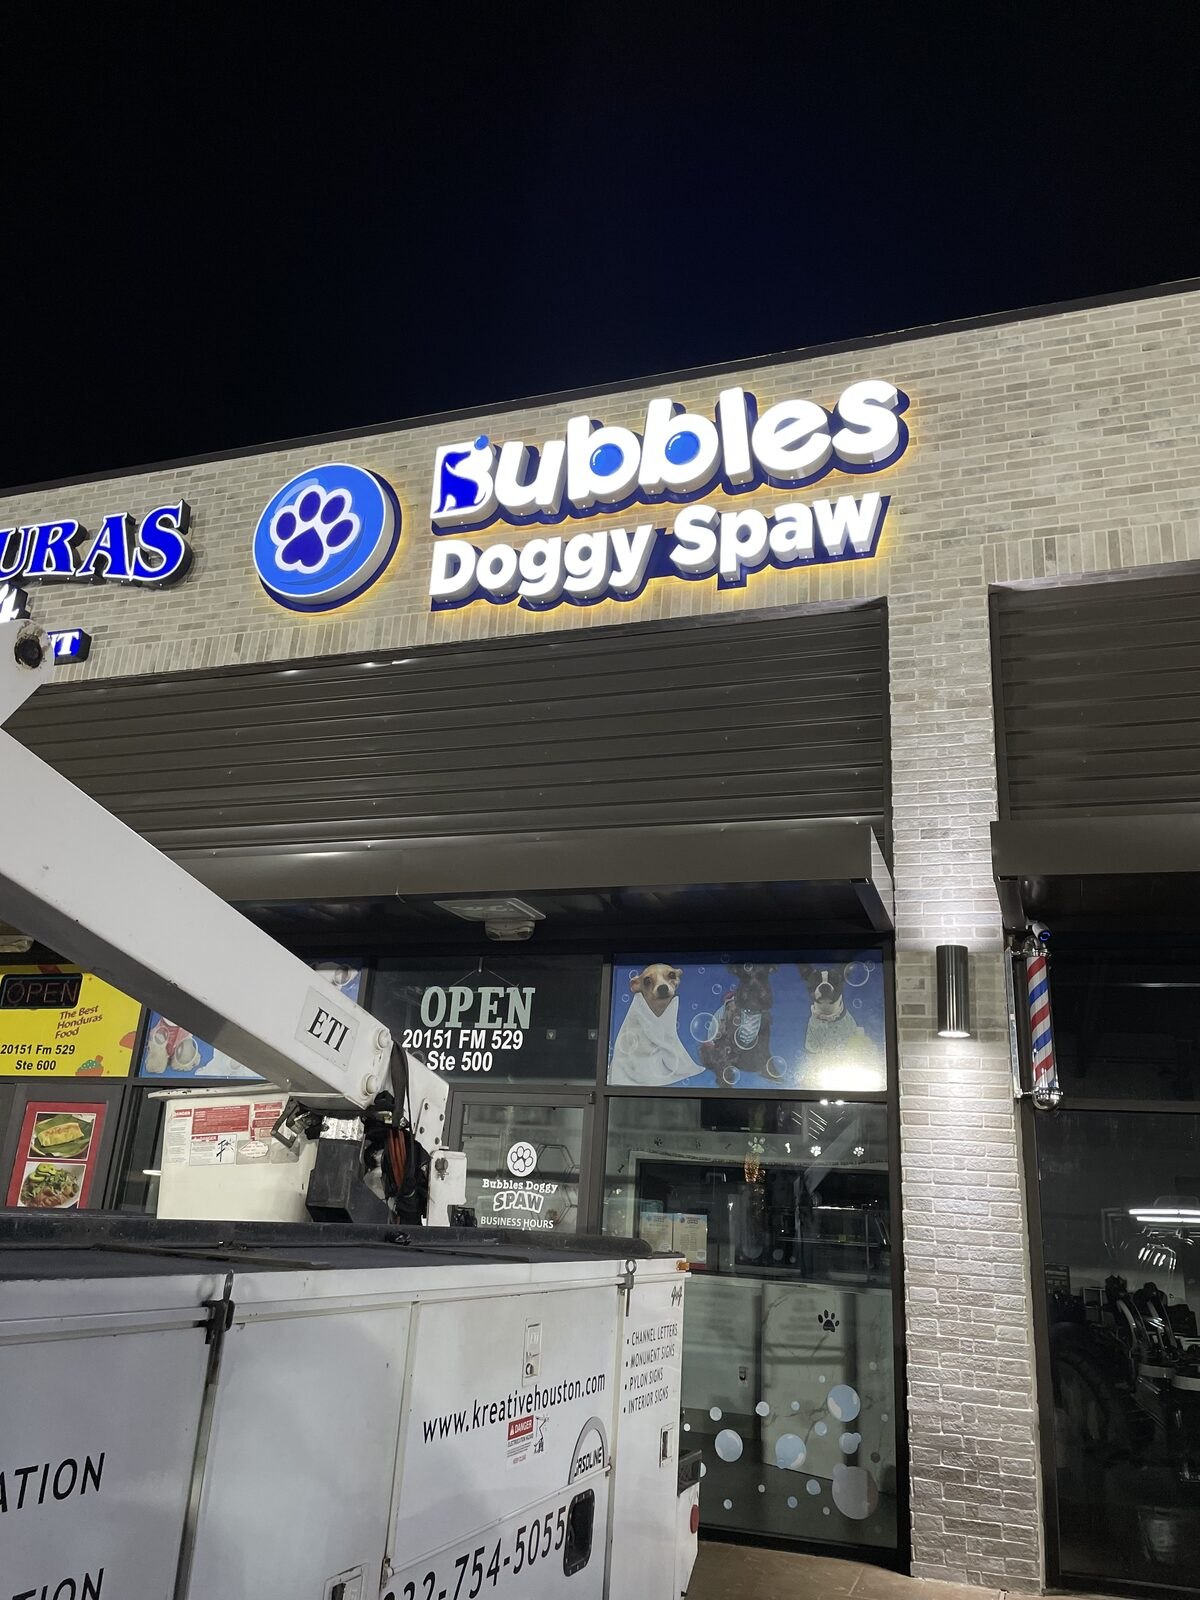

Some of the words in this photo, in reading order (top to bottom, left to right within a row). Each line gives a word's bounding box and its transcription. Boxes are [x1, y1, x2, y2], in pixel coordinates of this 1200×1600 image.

[430, 379, 902, 520] Bubbles
[429, 524, 656, 606] Doggy
[669, 491, 882, 581] Spaw
[7, 982, 79, 1003] OPEN
[60, 1009, 77, 1020] The
[79, 1005, 99, 1016] Best
[420, 985, 535, 1029] OPEN
[57, 1014, 103, 1029] Honduras
[307, 1007, 350, 1052] ETI
[55, 1027, 79, 1040] Food
[402, 1029, 452, 1049] 20151
[459, 1030, 486, 1049] FM
[491, 1030, 524, 1050] 529
[0, 1044, 33, 1055] 20151
[36, 1044, 52, 1055] Fm
[55, 1044, 75, 1055] 529
[15, 1060, 34, 1071] Ste
[37, 1060, 57, 1071] 600
[426, 1051, 455, 1071] Ste
[461, 1051, 493, 1071] 500
[482, 1178, 524, 1190] Bubbles
[525, 1181, 559, 1194] Doggy
[493, 1190, 544, 1213] SPAW
[480, 1216, 521, 1227] BUSINESS
[523, 1218, 554, 1229] HOURS
[631, 1327, 656, 1346] CHANNEL
[657, 1323, 678, 1340] LETTERS
[630, 1347, 660, 1368] MONUMENT
[661, 1343, 675, 1359] SIGNS
[629, 1373, 648, 1391] PYLON
[649, 1367, 663, 1385] SIGNS
[423, 1373, 605, 1444] www.kreativehouston.com
[628, 1391, 654, 1414] INTERIOR
[654, 1385, 669, 1404] SIGNS
[514, 1419, 532, 1434] DANGER
